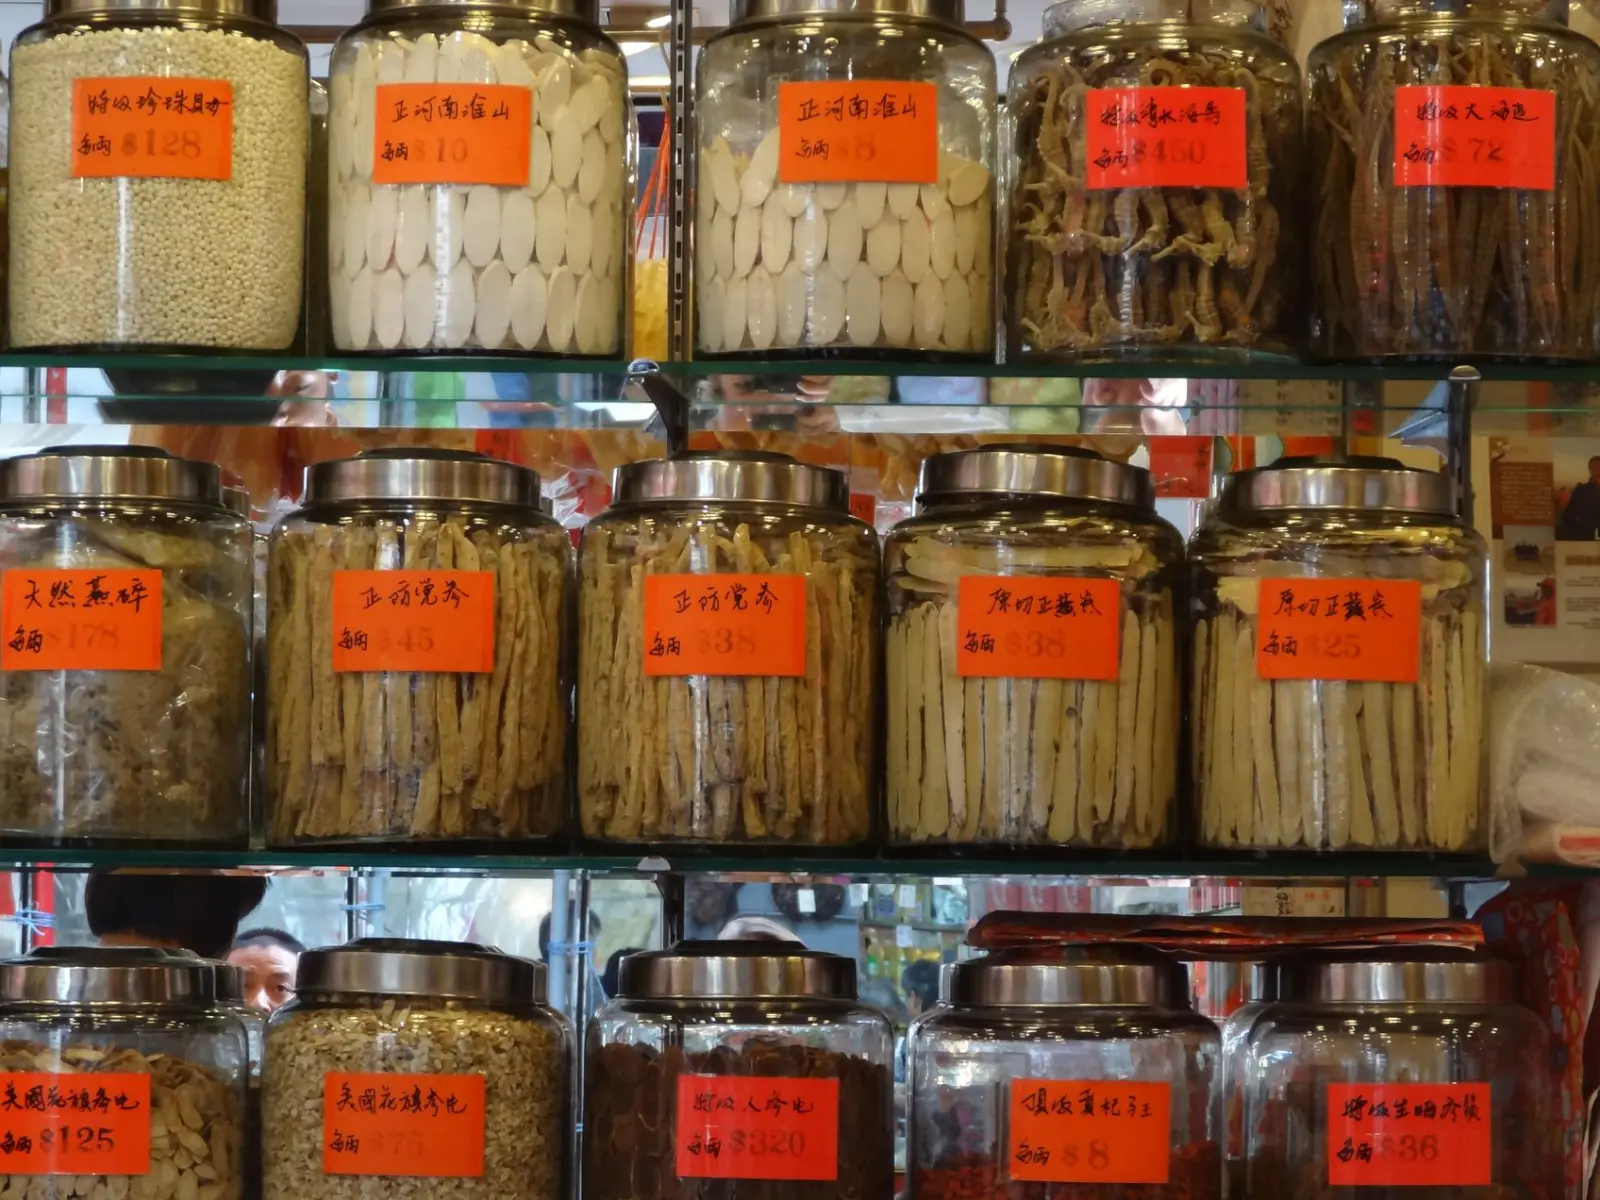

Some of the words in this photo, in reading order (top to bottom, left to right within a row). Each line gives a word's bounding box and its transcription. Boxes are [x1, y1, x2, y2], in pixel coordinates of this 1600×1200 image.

[121, 128, 201, 159] $128
[39, 1125, 115, 1153] $125
[729, 1128, 805, 1156] $320
[1378, 1134, 1439, 1161] $36
